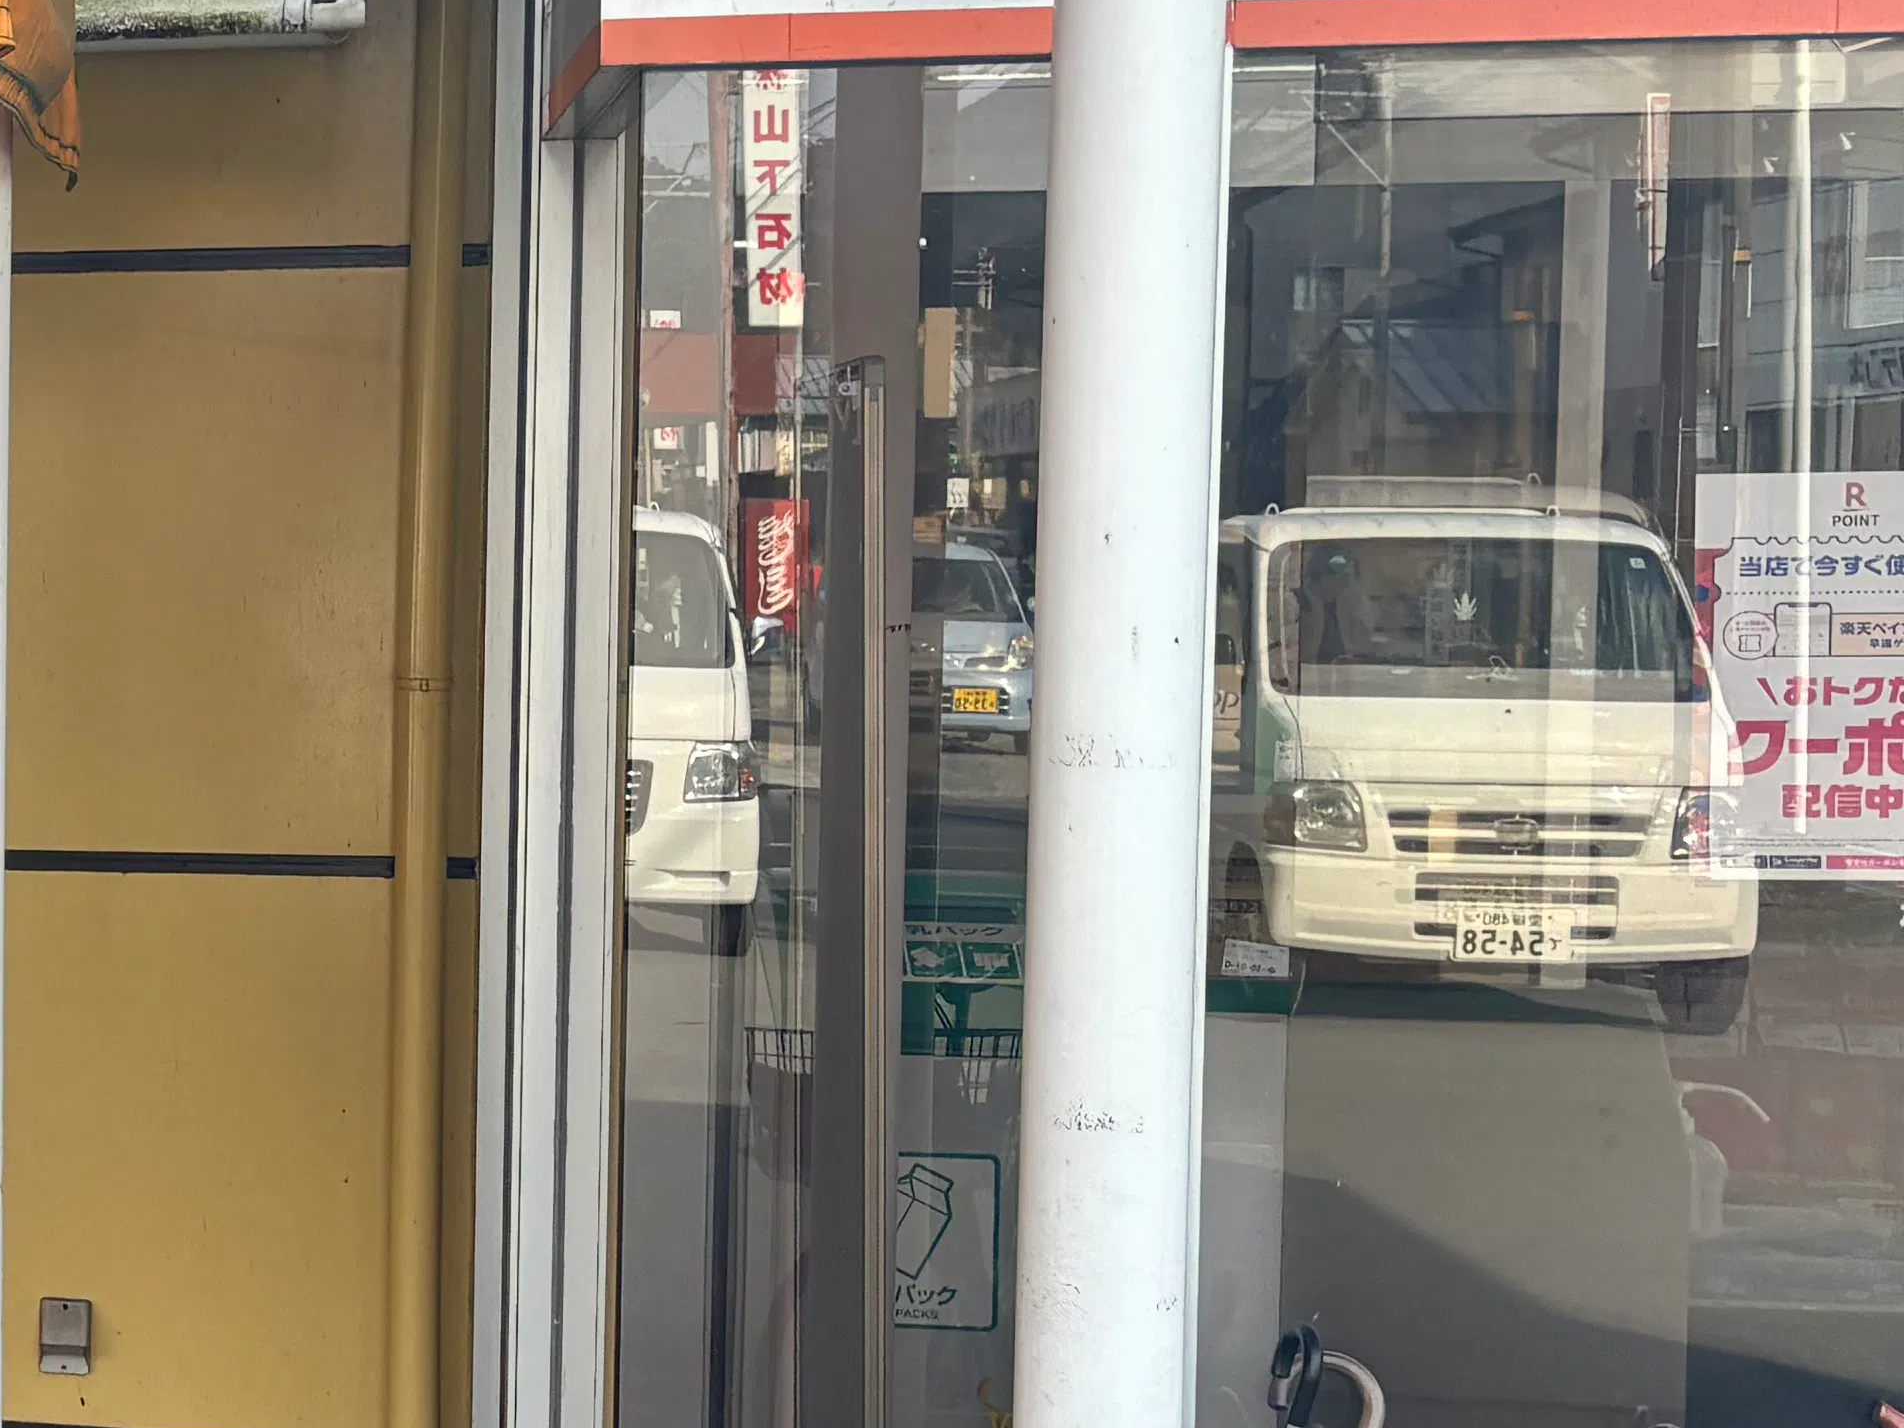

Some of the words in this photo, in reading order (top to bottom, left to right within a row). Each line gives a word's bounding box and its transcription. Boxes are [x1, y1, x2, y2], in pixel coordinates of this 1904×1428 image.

[1845, 482, 1868, 508] R
[1832, 515, 1880, 527] POINT
[1782, 785, 1904, 818] 配信中
